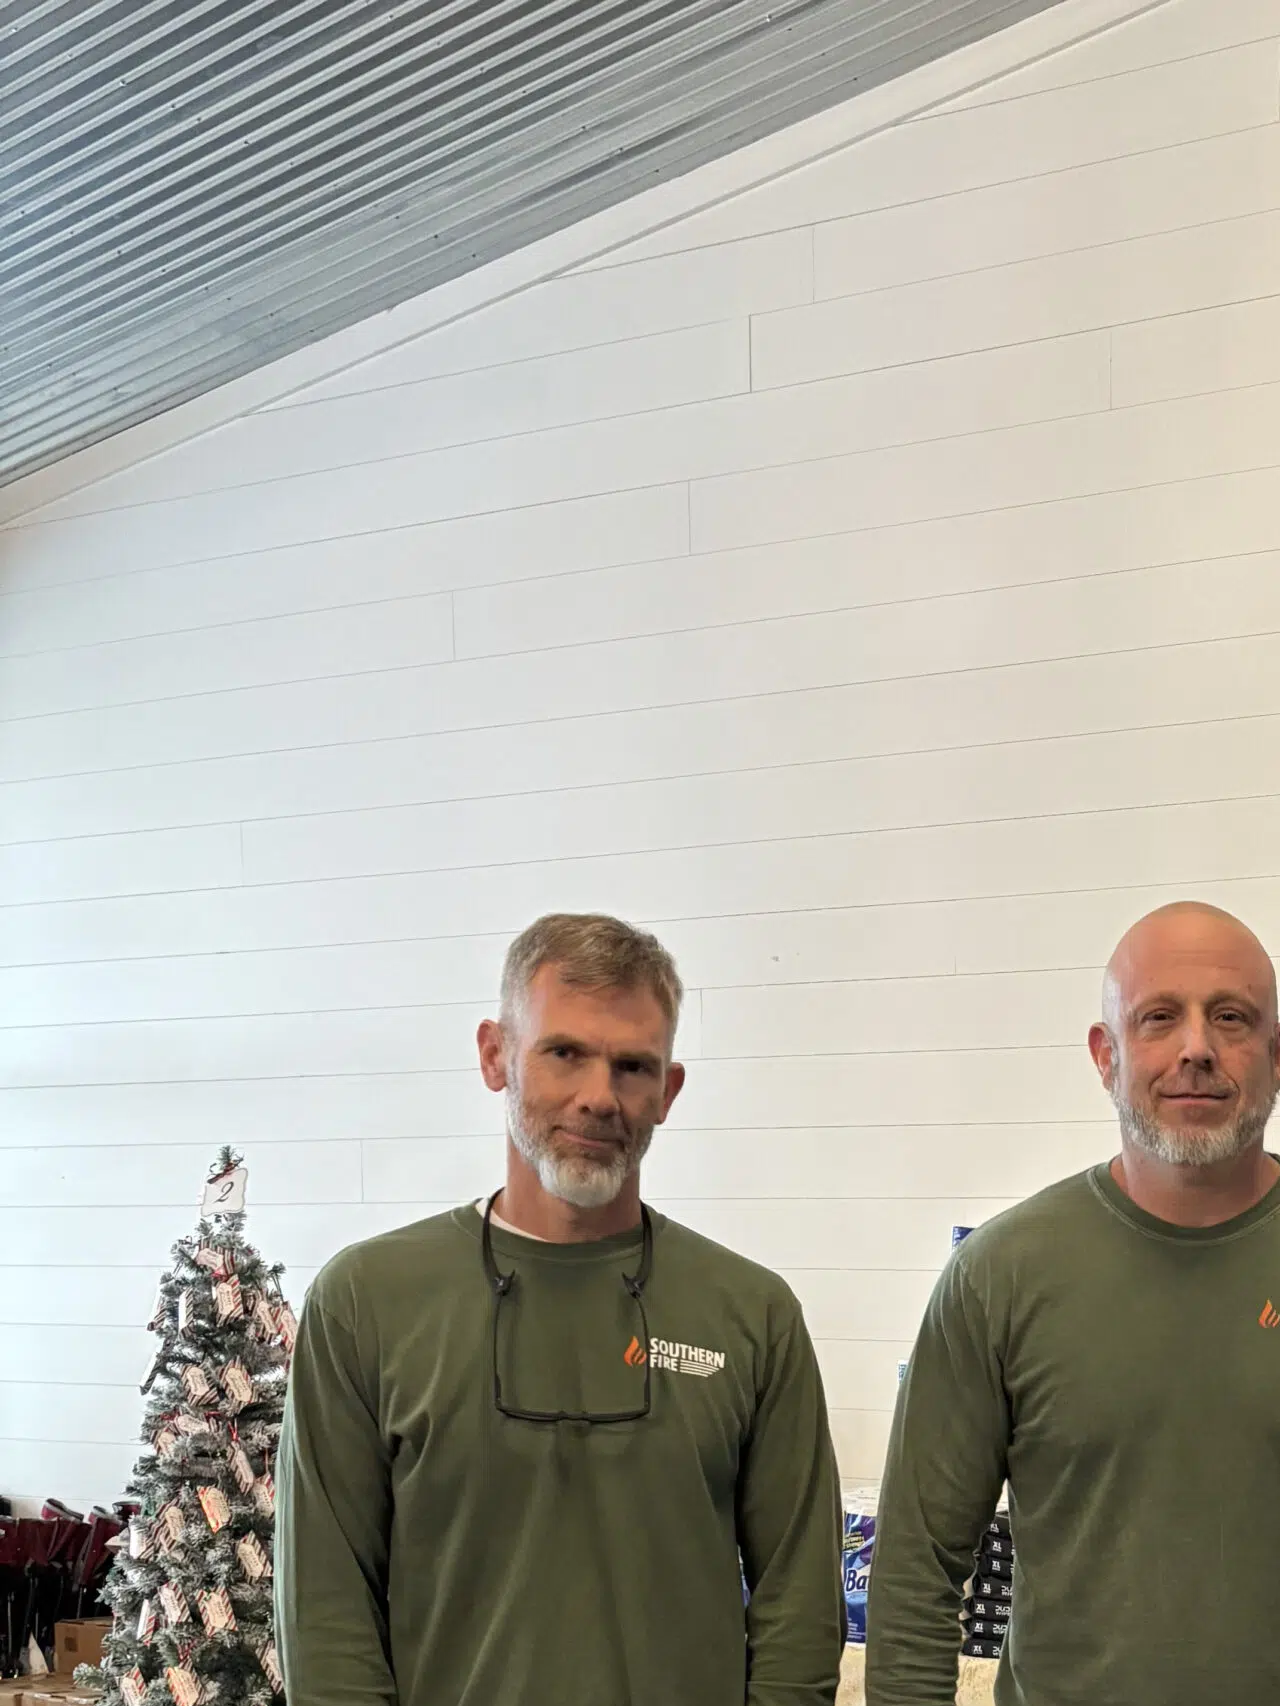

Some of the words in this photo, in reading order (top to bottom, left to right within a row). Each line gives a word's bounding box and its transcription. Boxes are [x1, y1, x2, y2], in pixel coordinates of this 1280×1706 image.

[213, 1181, 234, 1204] 2
[649, 1337, 726, 1369] SOUTHERN
[649, 1354, 679, 1372] FIRE
